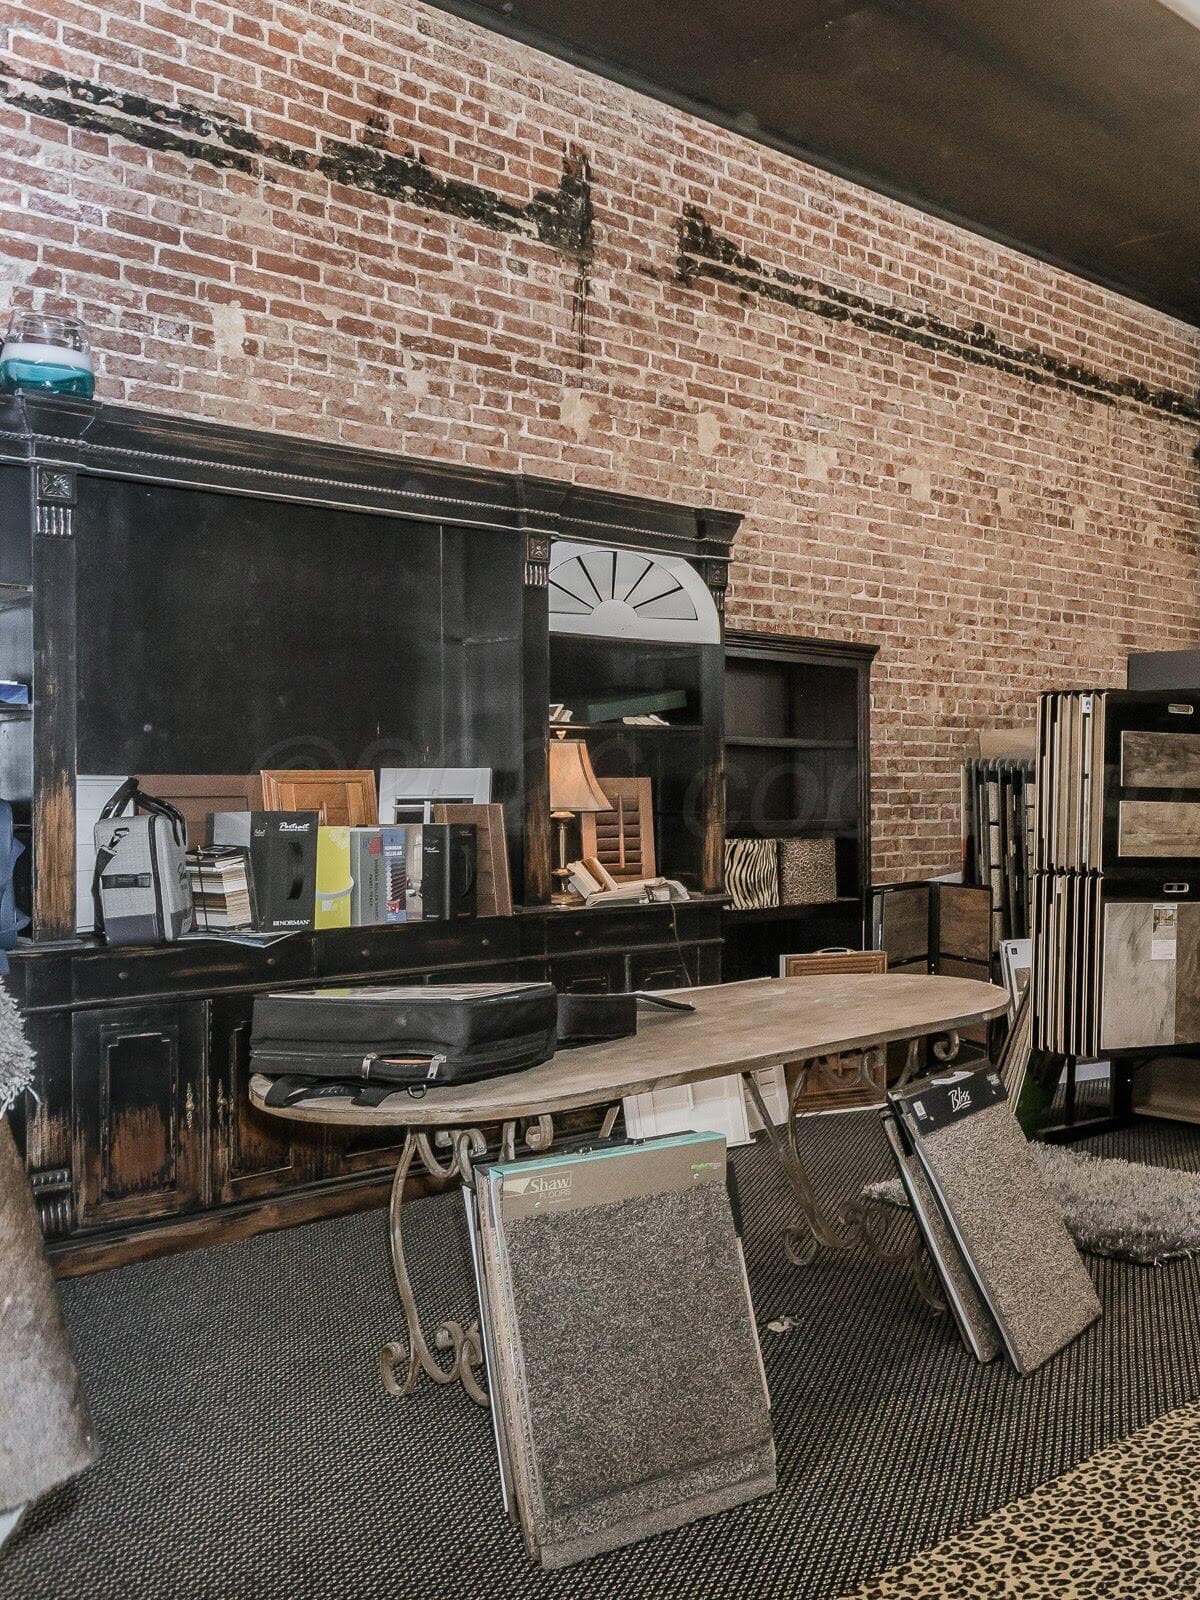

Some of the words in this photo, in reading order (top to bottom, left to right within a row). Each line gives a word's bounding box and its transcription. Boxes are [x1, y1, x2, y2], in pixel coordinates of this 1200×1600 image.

[280, 919, 309, 927] NORMAN
[948, 1087, 971, 1112] Bliss
[530, 1175, 570, 1194] Shaw
[539, 1189, 571, 1200] FLOORS
